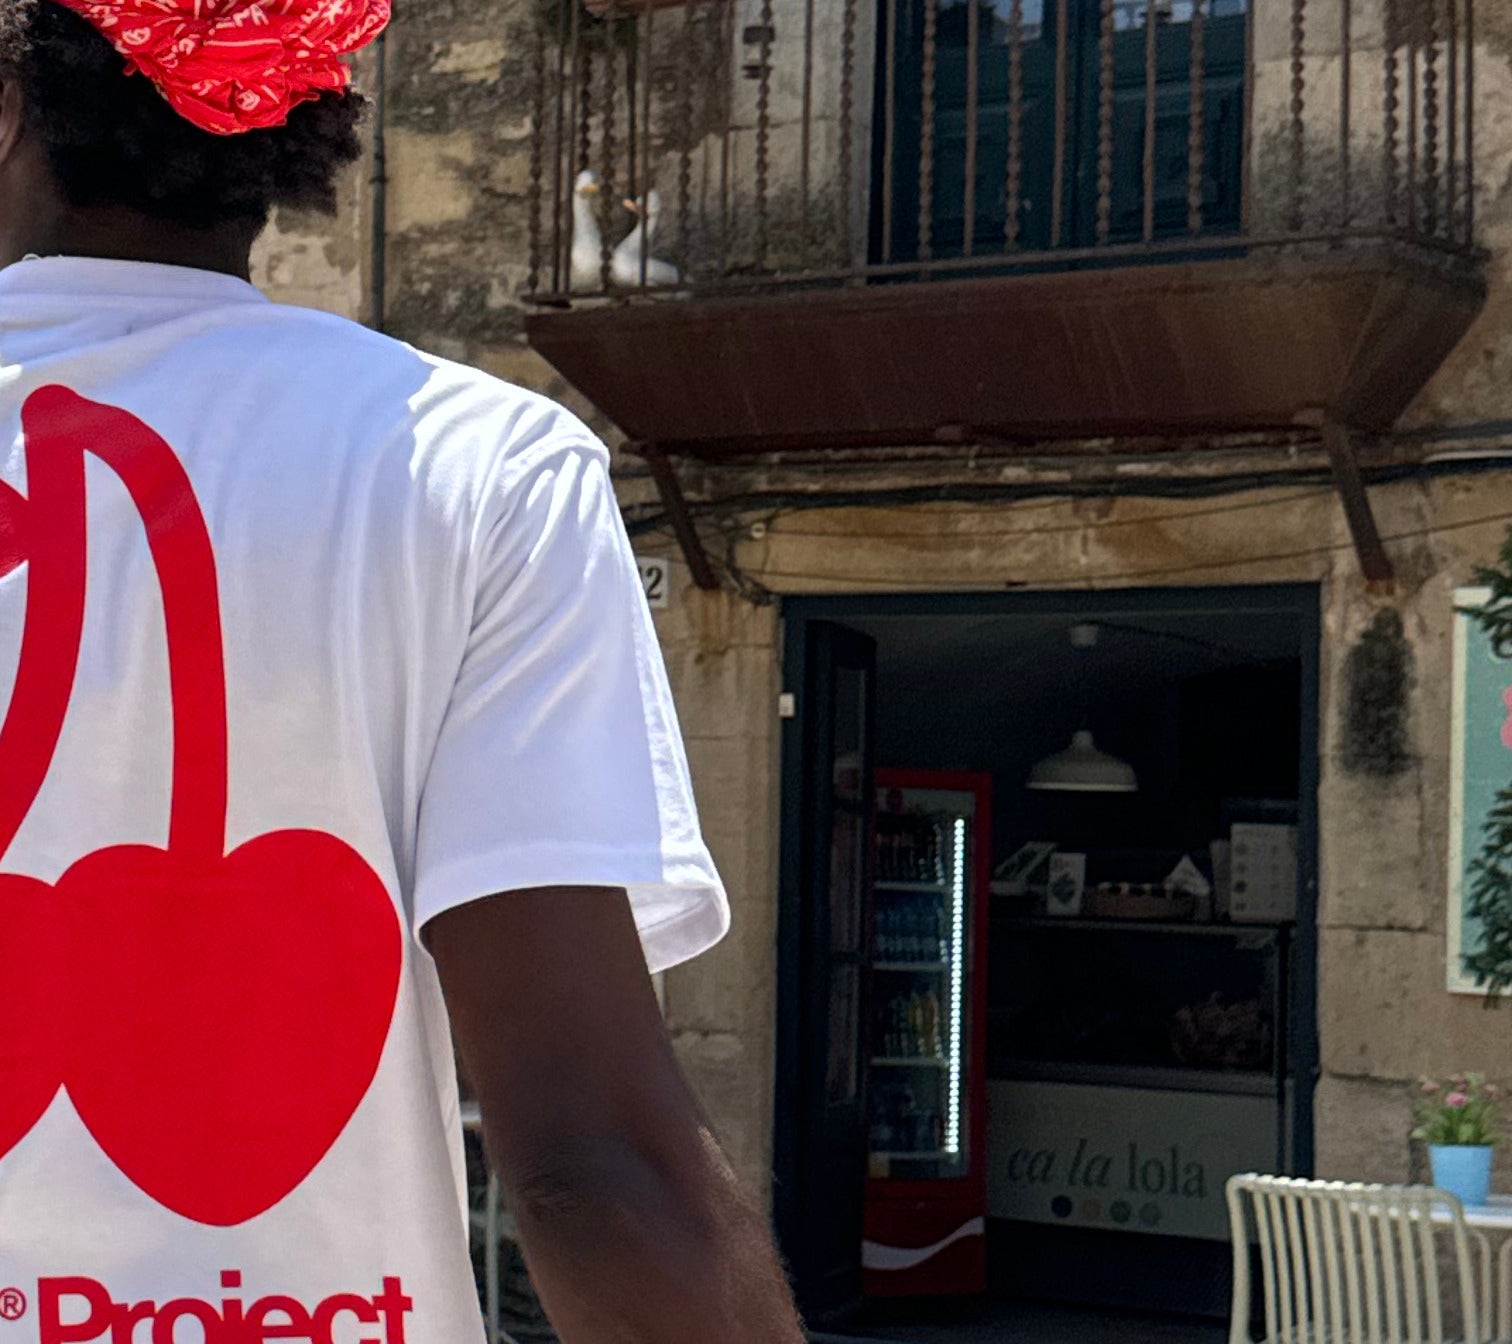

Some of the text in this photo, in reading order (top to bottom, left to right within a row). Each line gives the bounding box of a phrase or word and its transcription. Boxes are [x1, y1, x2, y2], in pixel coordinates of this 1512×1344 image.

[1007, 1138, 1208, 1198] ca la lola
